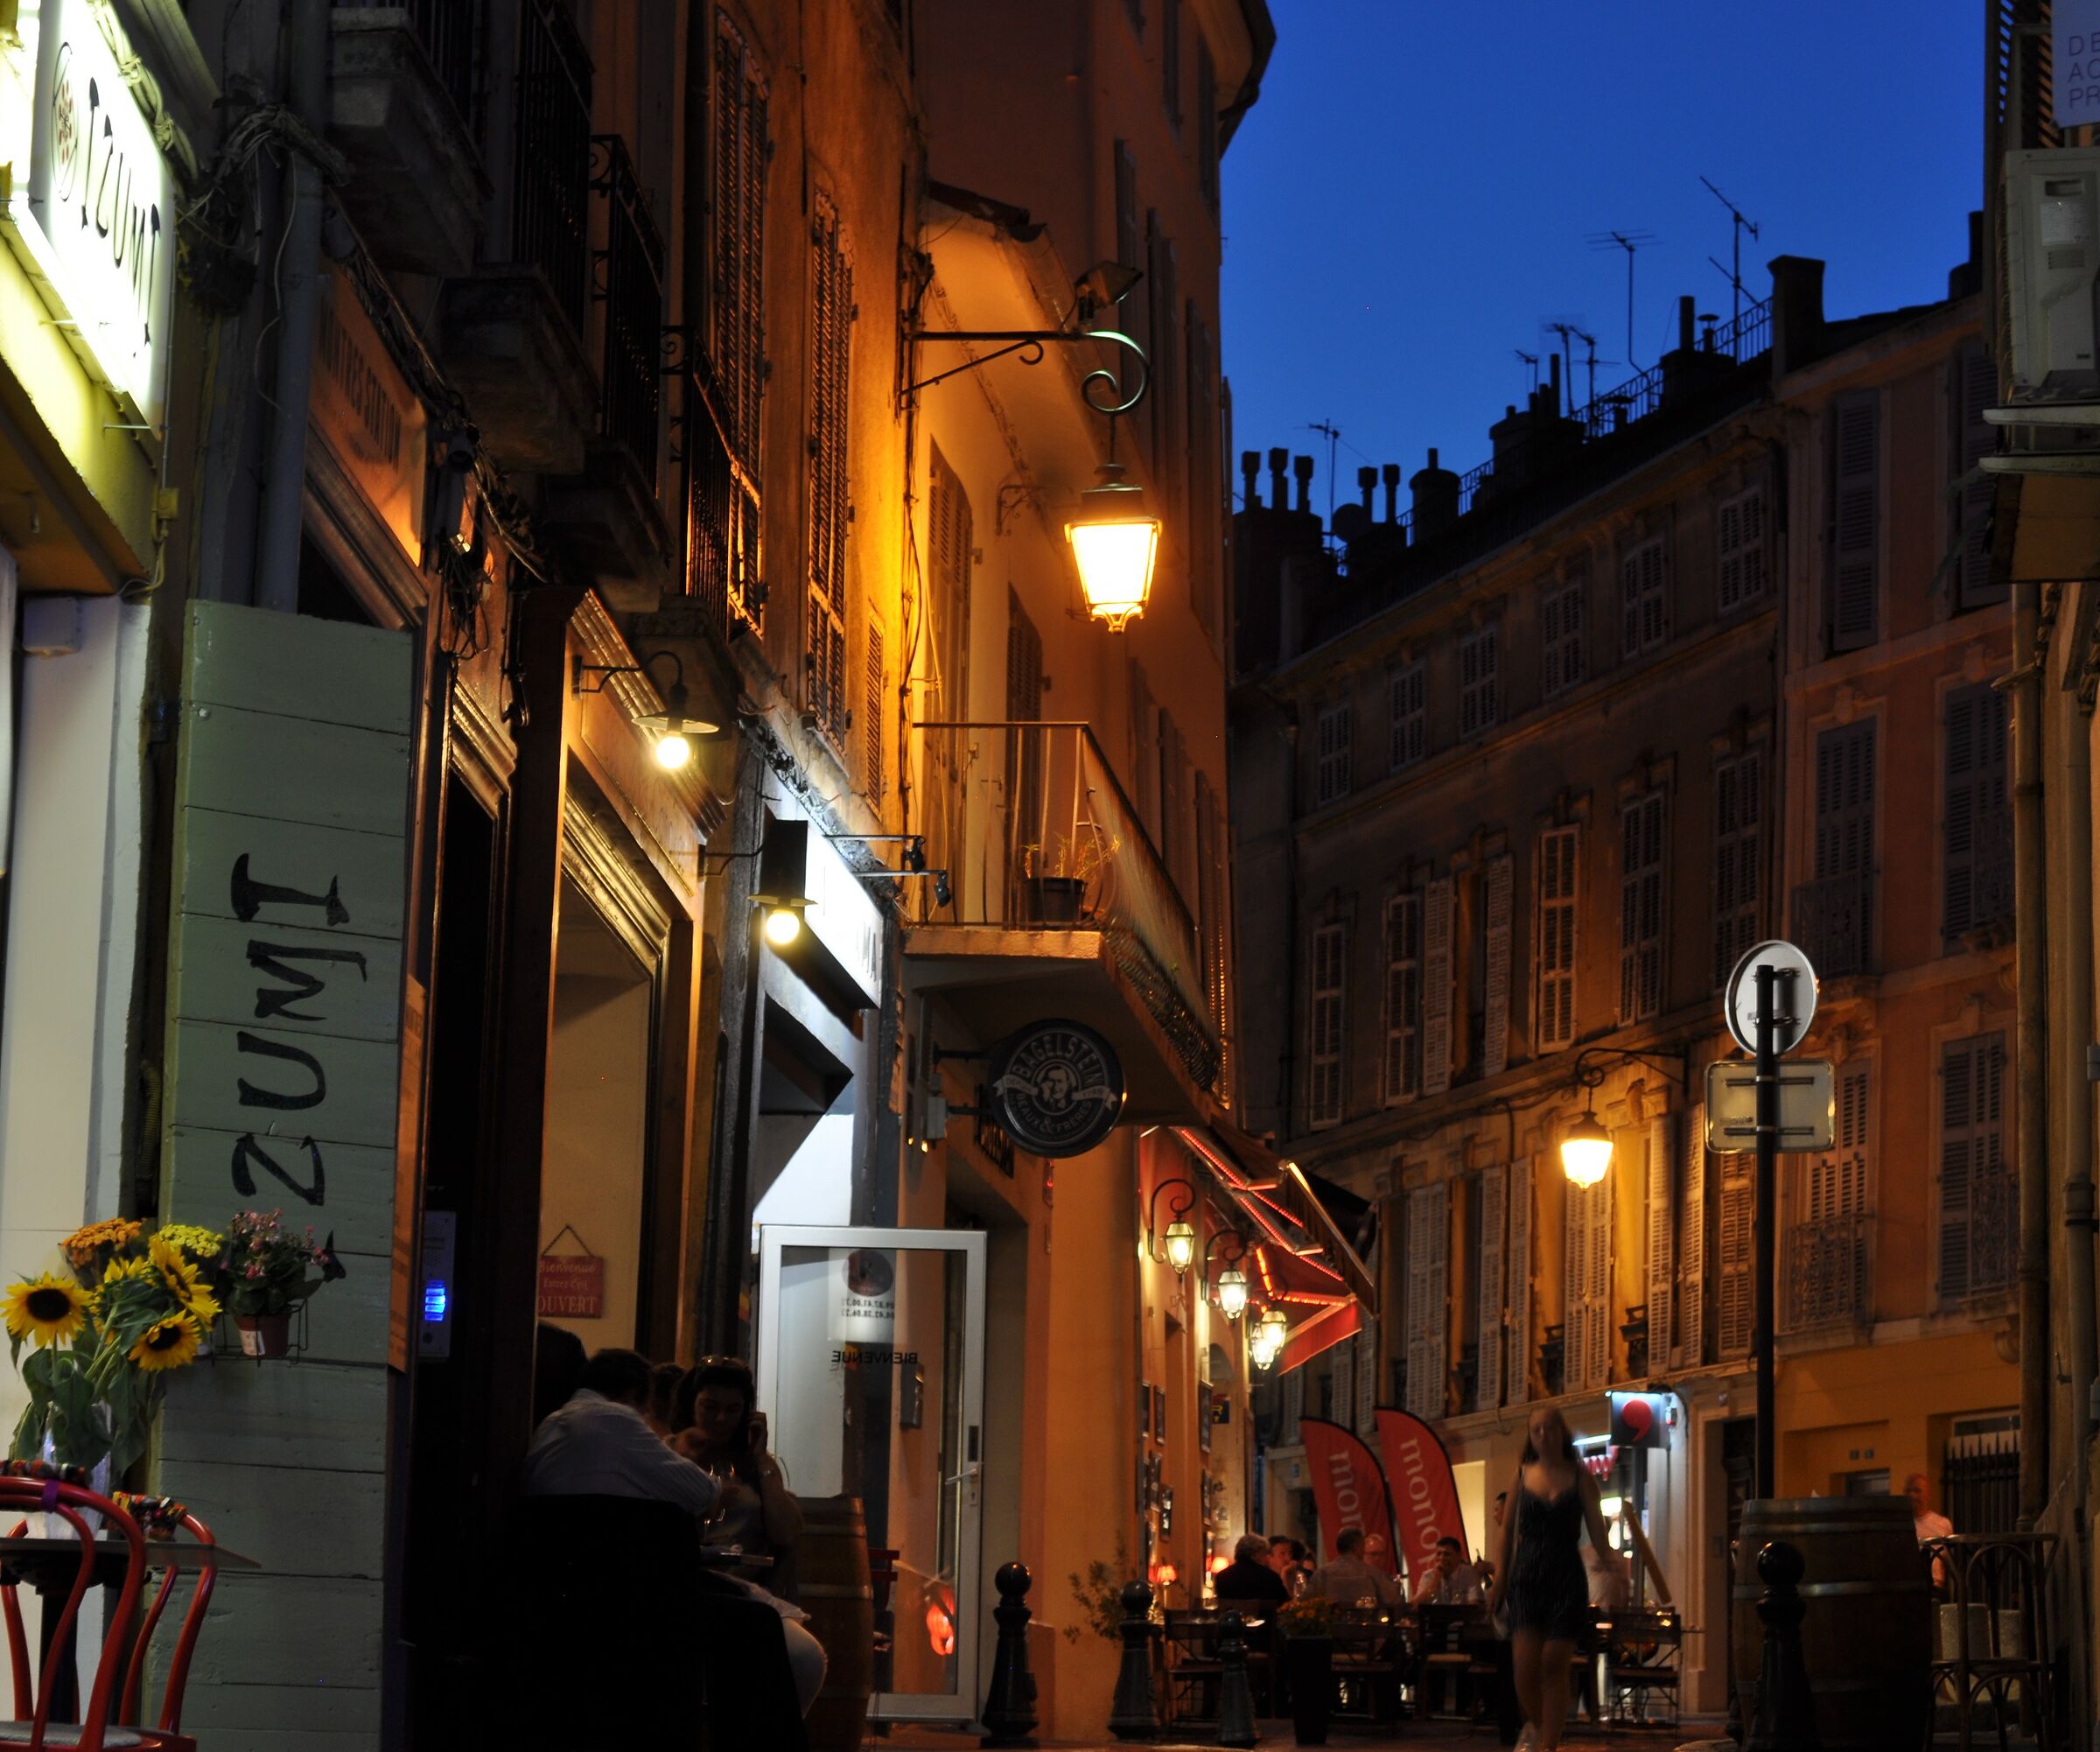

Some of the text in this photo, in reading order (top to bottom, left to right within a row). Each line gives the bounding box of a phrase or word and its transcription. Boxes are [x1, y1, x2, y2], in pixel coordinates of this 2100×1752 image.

[230, 853, 368, 1282] ZUMI
[1012, 1034, 1104, 1086] BAGELSTEIN
[1015, 1092, 1040, 1128] BEAUX
[1040, 1117, 1054, 1134] &
[538, 1295, 597, 1314] OUVERT
